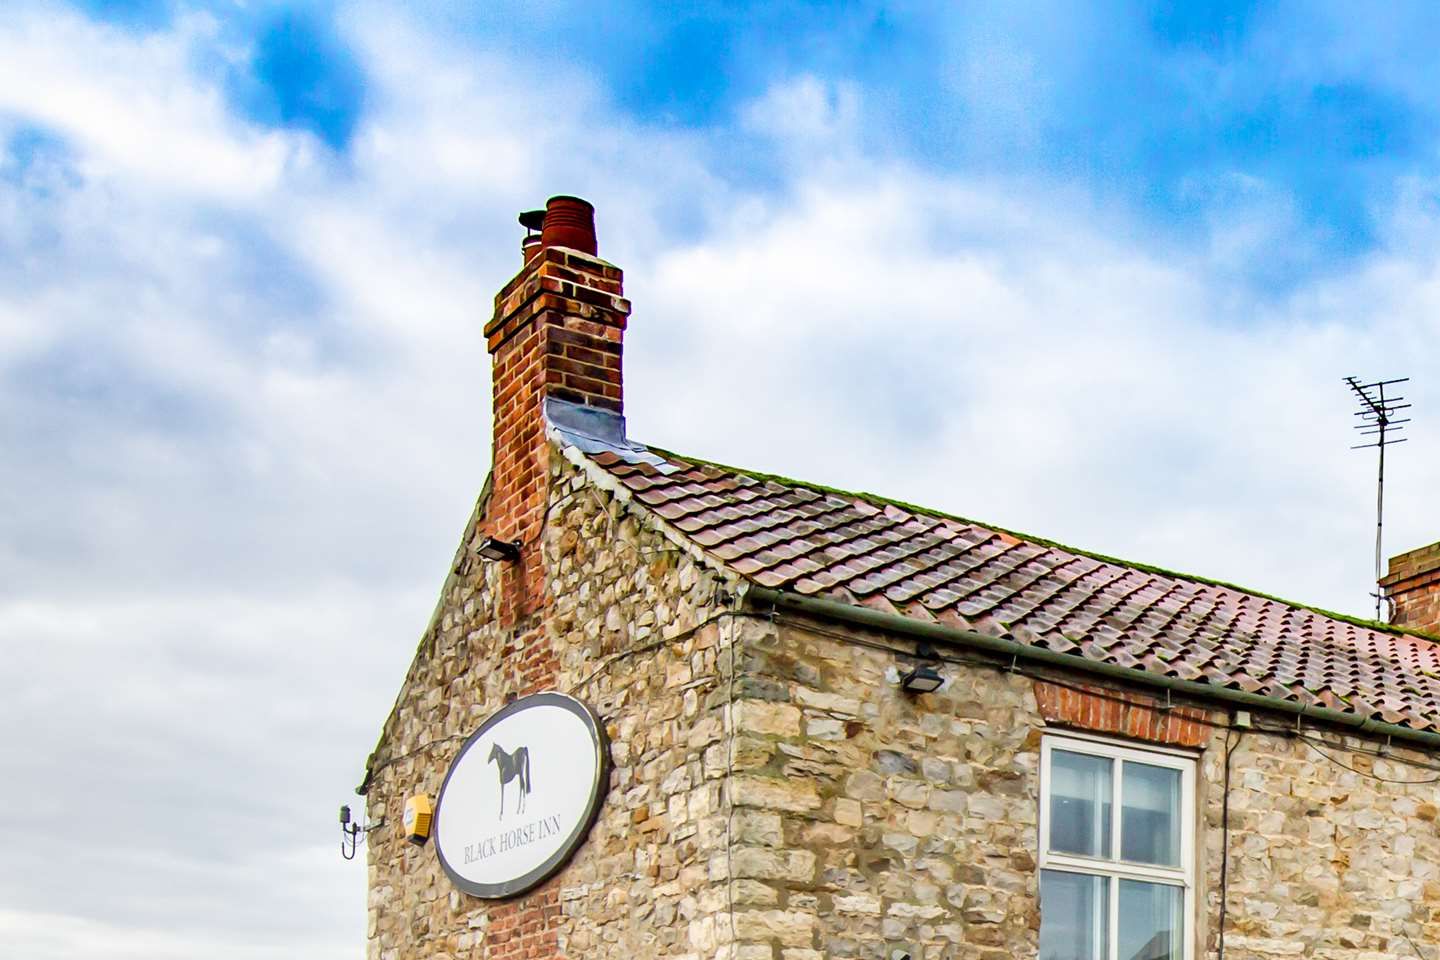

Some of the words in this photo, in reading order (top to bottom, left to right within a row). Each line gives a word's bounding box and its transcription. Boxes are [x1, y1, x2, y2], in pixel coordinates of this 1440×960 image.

[464, 837, 496, 864] BLACK
[500, 824, 535, 852] HORSE
[538, 814, 561, 840] INN
